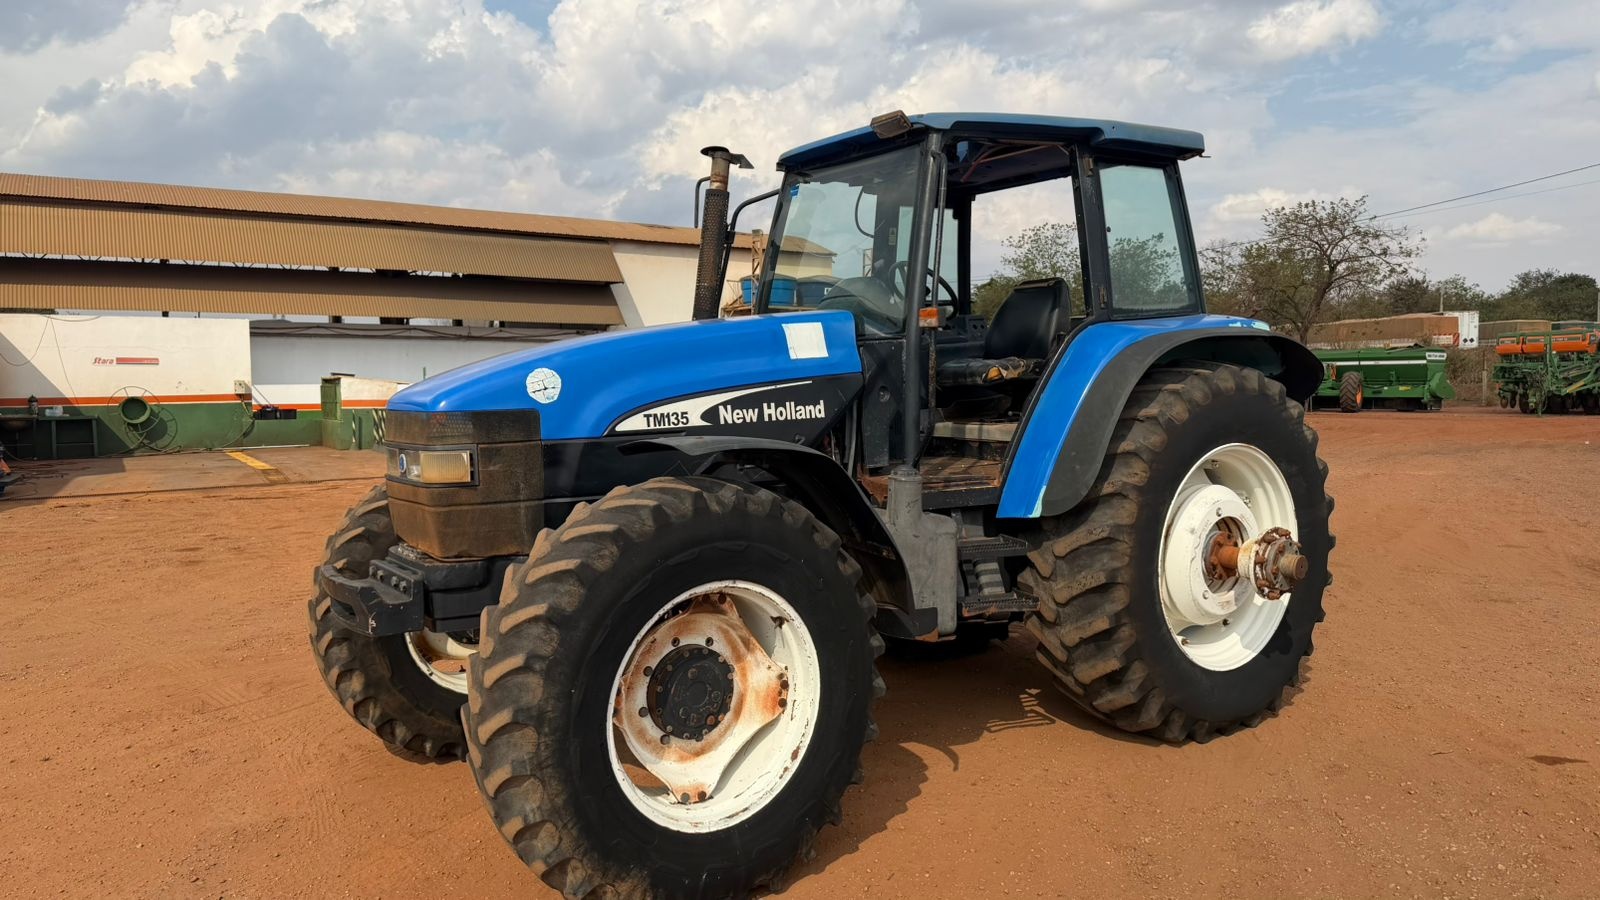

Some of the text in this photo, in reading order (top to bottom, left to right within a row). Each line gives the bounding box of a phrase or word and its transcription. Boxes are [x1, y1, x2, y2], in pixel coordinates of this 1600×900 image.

[643, 412, 688, 428] TM135
[718, 400, 825, 424] New Holland
